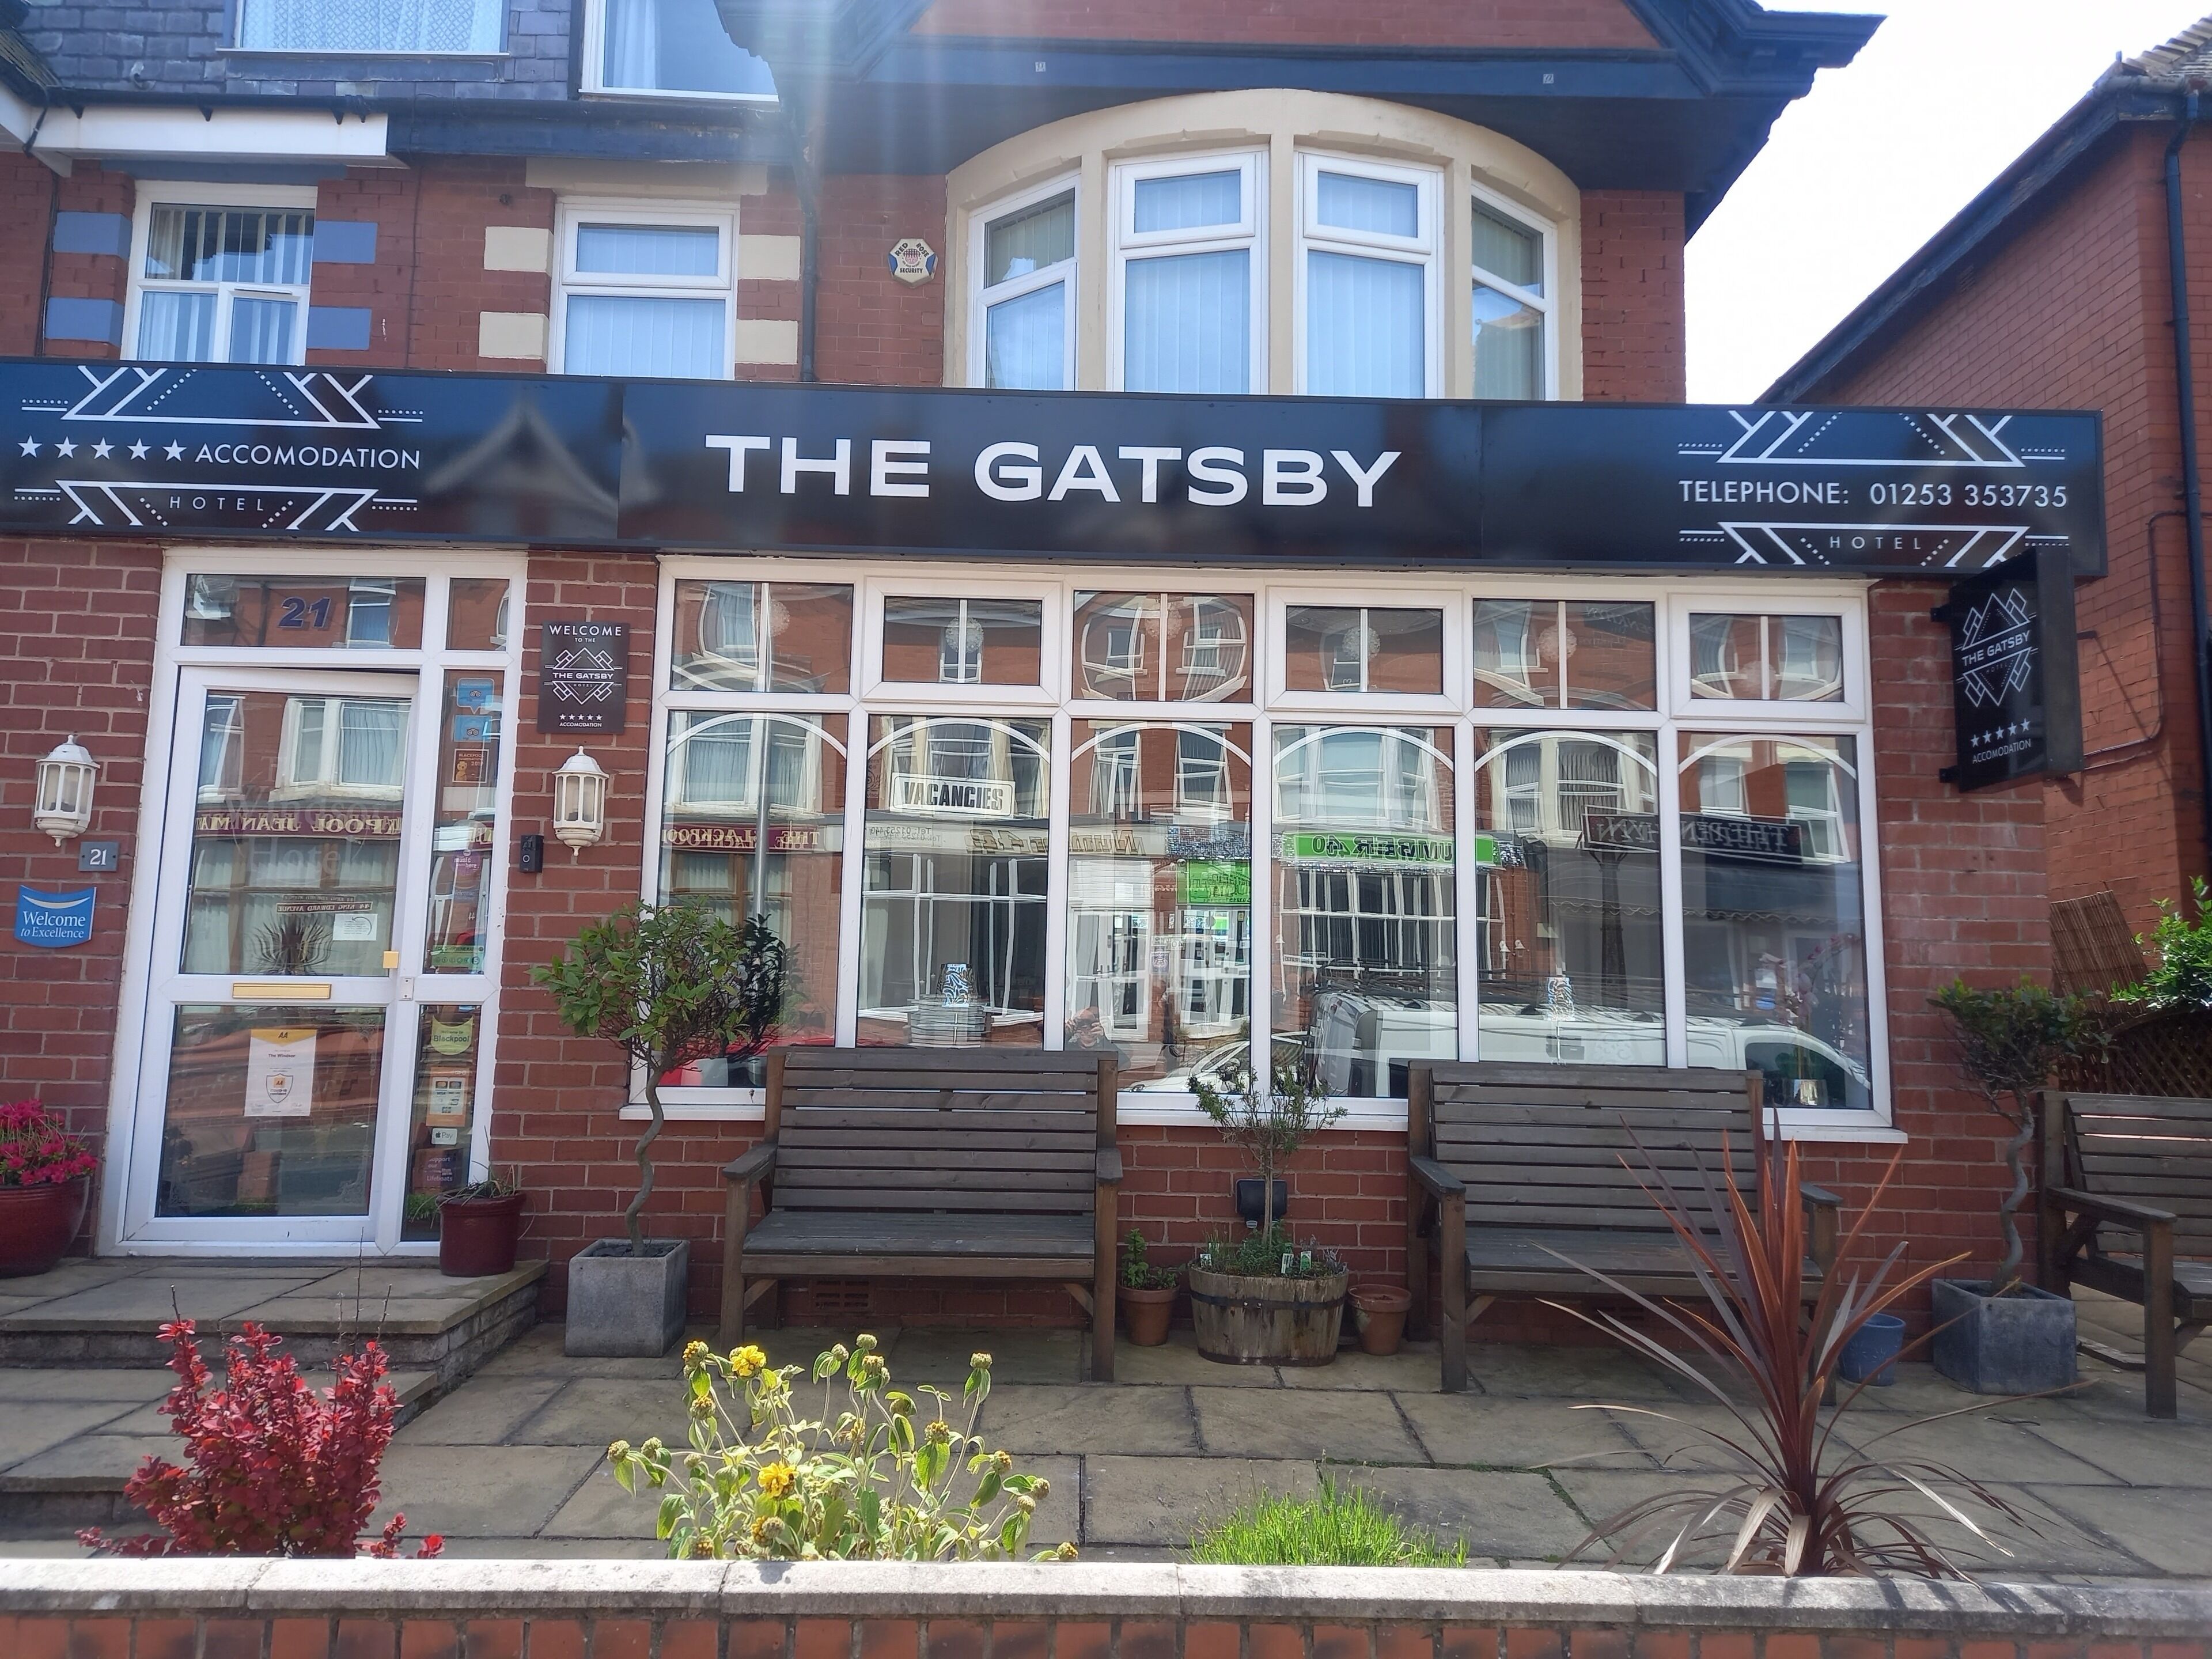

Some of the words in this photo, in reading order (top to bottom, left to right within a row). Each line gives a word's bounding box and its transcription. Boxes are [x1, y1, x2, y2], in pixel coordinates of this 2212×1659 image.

[895, 243, 908, 256] RED
[916, 243, 930, 257] ROSE
[195, 443, 421, 469] ACCOMODATION
[705, 434, 930, 497] THE
[974, 441, 1402, 507] GATSBY
[1679, 480, 1849, 505] TELEPHONE:
[1869, 482, 1952, 507] 01253
[1964, 484, 2067, 509] 353735
[169, 495, 264, 512] HOTEL
[1830, 536, 1922, 551] HOTEL
[279, 596, 331, 628] 21
[549, 625, 622, 637] WELCOME
[1961, 649, 1984, 667] THE
[1987, 630, 2031, 657] GATSBY
[1972, 738, 2031, 764] ACCOMODATION
[904, 781, 1003, 810] VACANCIES
[89, 849, 107, 866] 21
[23, 911, 86, 927] Welcome
[21, 928, 31, 937] to
[32, 926, 85, 939] Excellence
[433, 1035, 469, 1043] Blackpool
[441, 1131, 453, 1139] Pay
